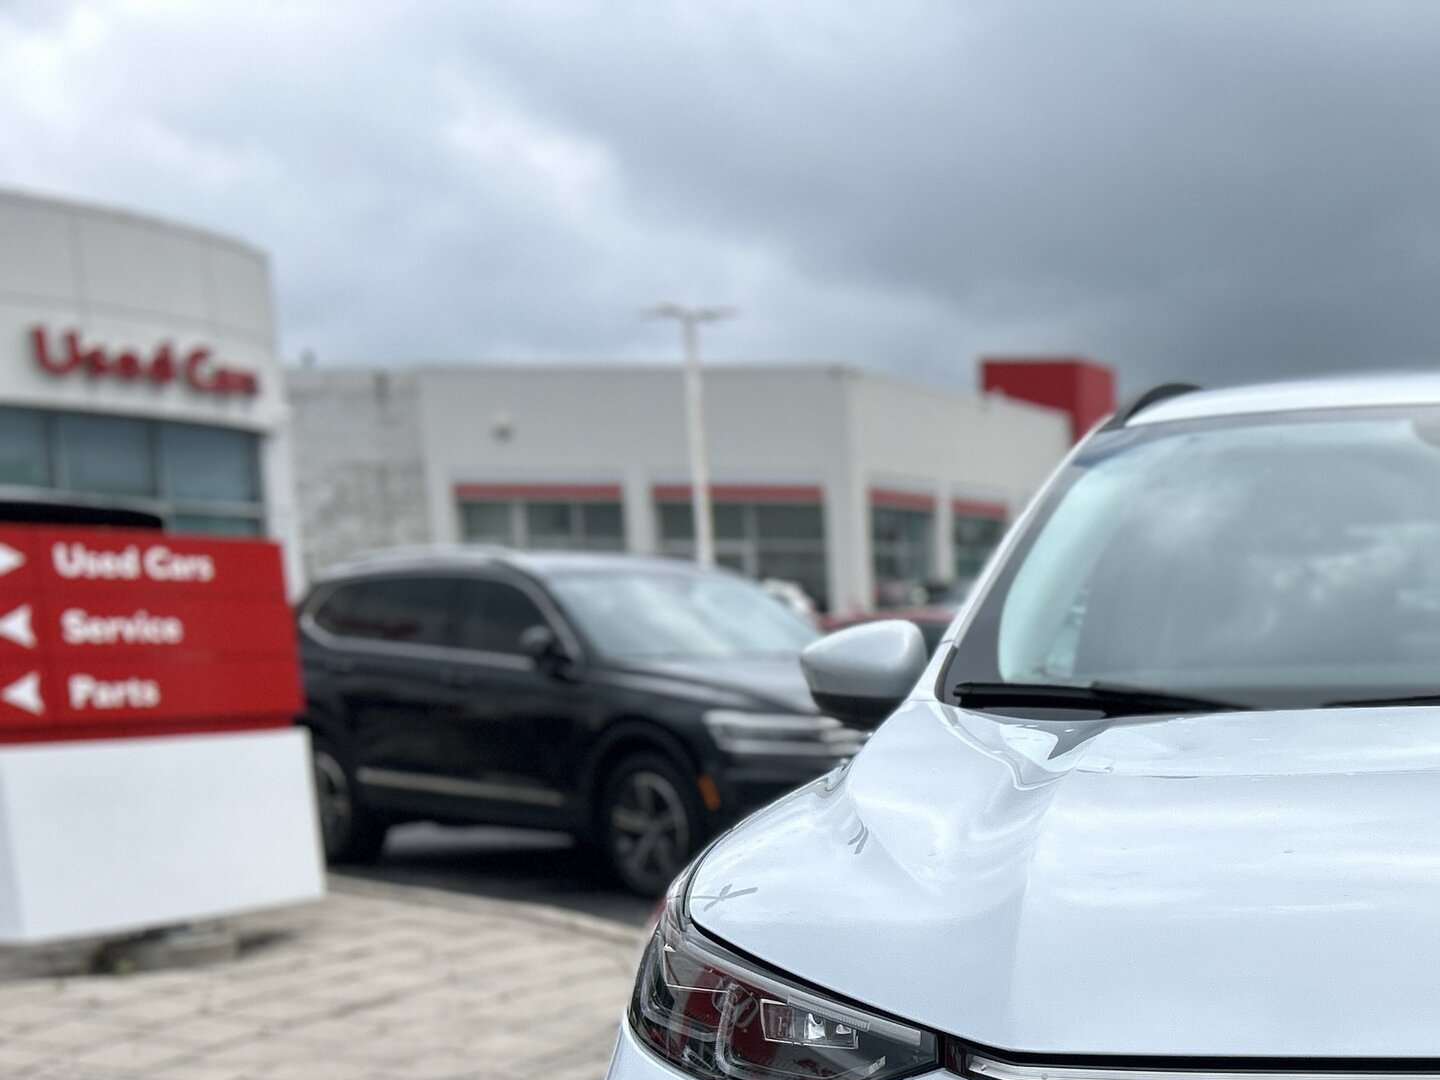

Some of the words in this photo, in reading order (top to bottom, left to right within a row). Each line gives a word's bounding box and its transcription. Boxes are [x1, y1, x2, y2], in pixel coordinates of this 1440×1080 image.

[31, 325, 174, 389] Used
[185, 347, 259, 395] Cars
[52, 542, 139, 581] Used
[144, 546, 215, 582] Cars
[61, 607, 183, 645] Service
[68, 672, 160, 708] Parts
